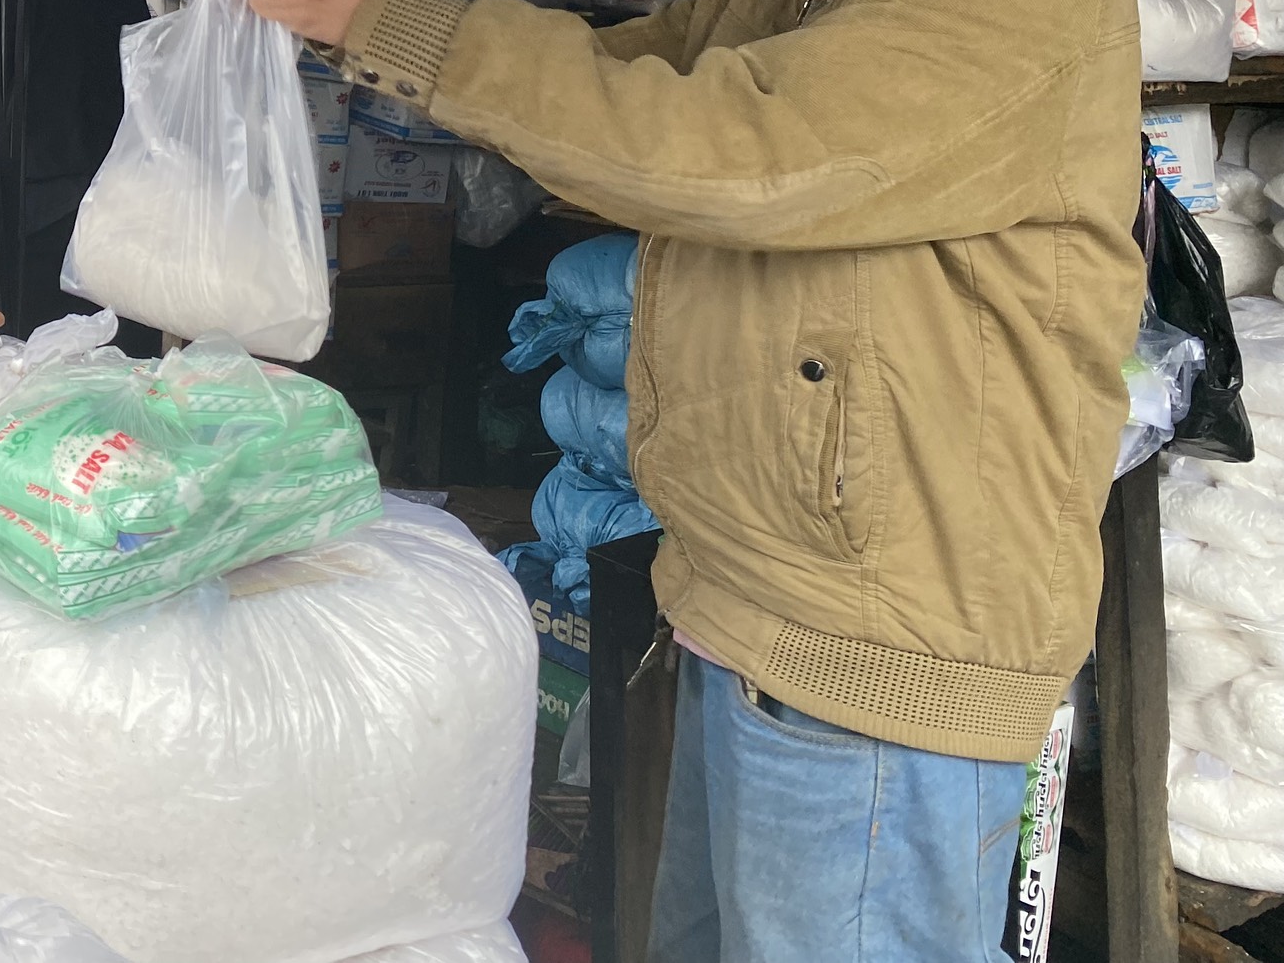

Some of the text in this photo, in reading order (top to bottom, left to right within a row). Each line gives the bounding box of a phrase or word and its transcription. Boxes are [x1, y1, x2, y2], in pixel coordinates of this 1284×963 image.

[1167, 166, 1182, 175] SALT
[72, 450, 110, 495] SALT
[531, 599, 591, 654] EPS
